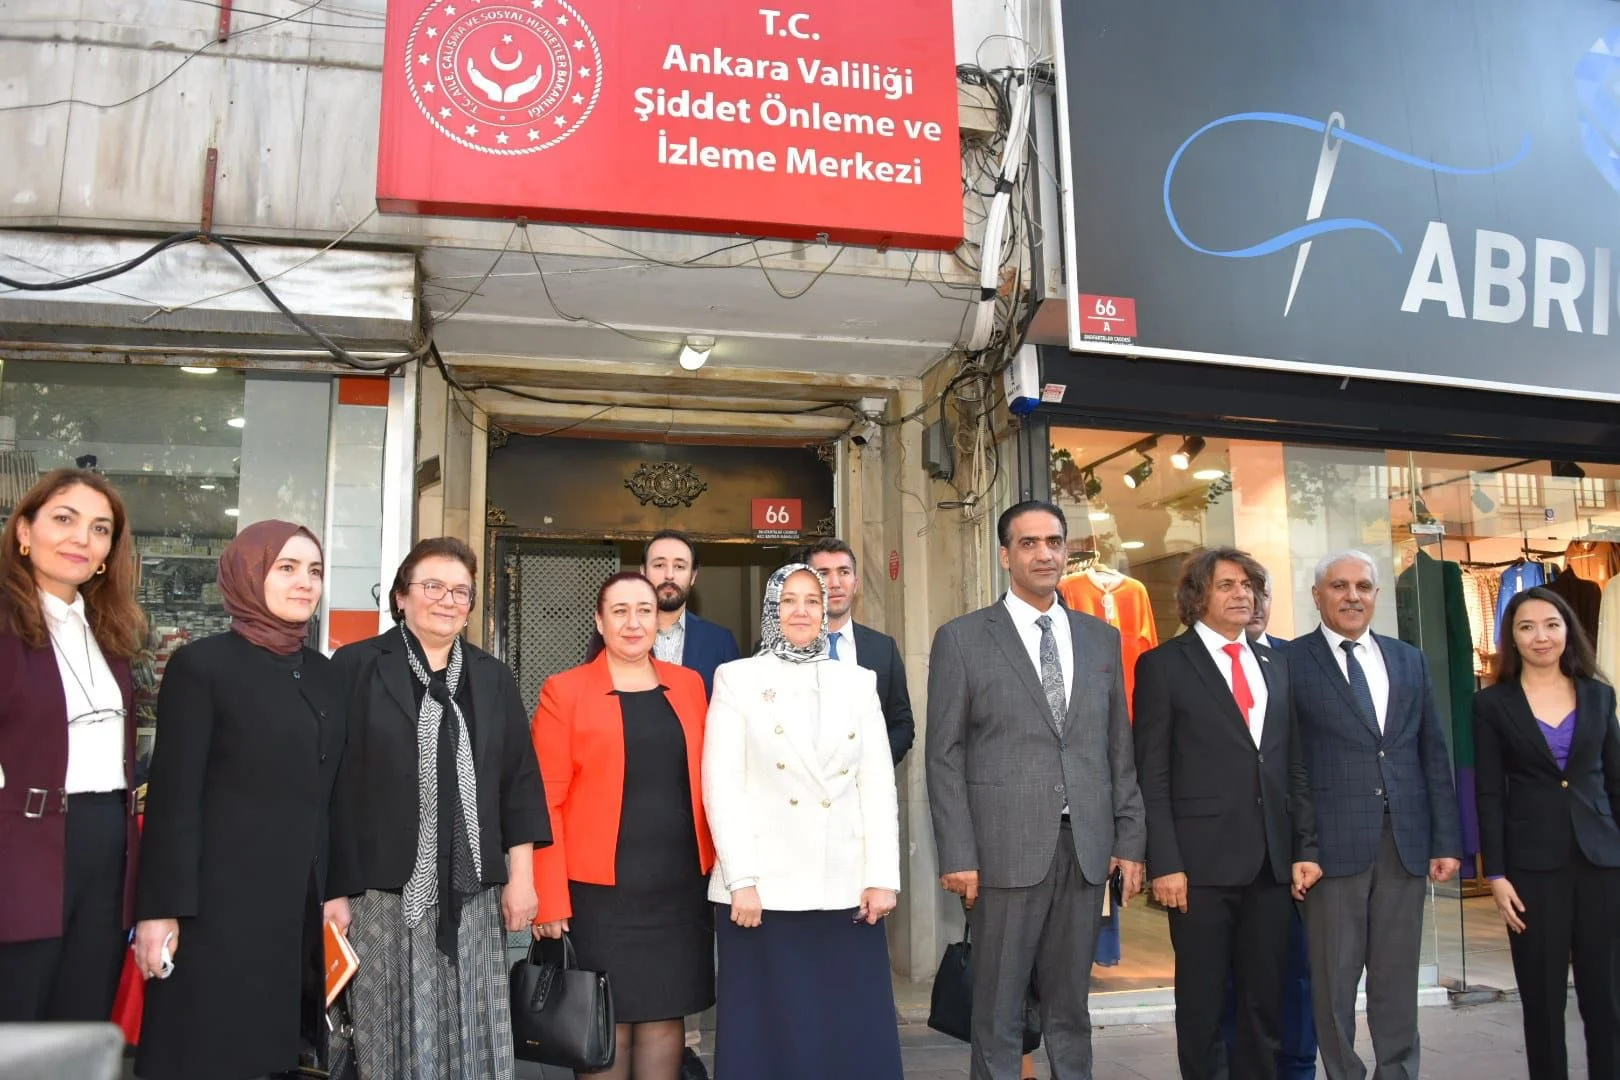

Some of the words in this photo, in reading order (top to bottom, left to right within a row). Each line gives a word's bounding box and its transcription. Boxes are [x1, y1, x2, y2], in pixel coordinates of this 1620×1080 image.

[464, 16, 481, 28] VE
[480, 10, 525, 22] SOSYAL
[758, 8, 821, 41] T.C.
[662, 44, 790, 82] Ankara
[796, 57, 914, 101] Valiliği
[633, 86, 751, 123] Şiddet
[759, 92, 896, 137] Önleme
[902, 118, 943, 142] ve
[657, 128, 778, 173] İzleme
[785, 146, 923, 186] Merkezi
[1400, 219, 1620, 337] ABRI
[1095, 298, 1116, 316] 66
[1103, 321, 1111, 332] A
[765, 505, 790, 524] 66
